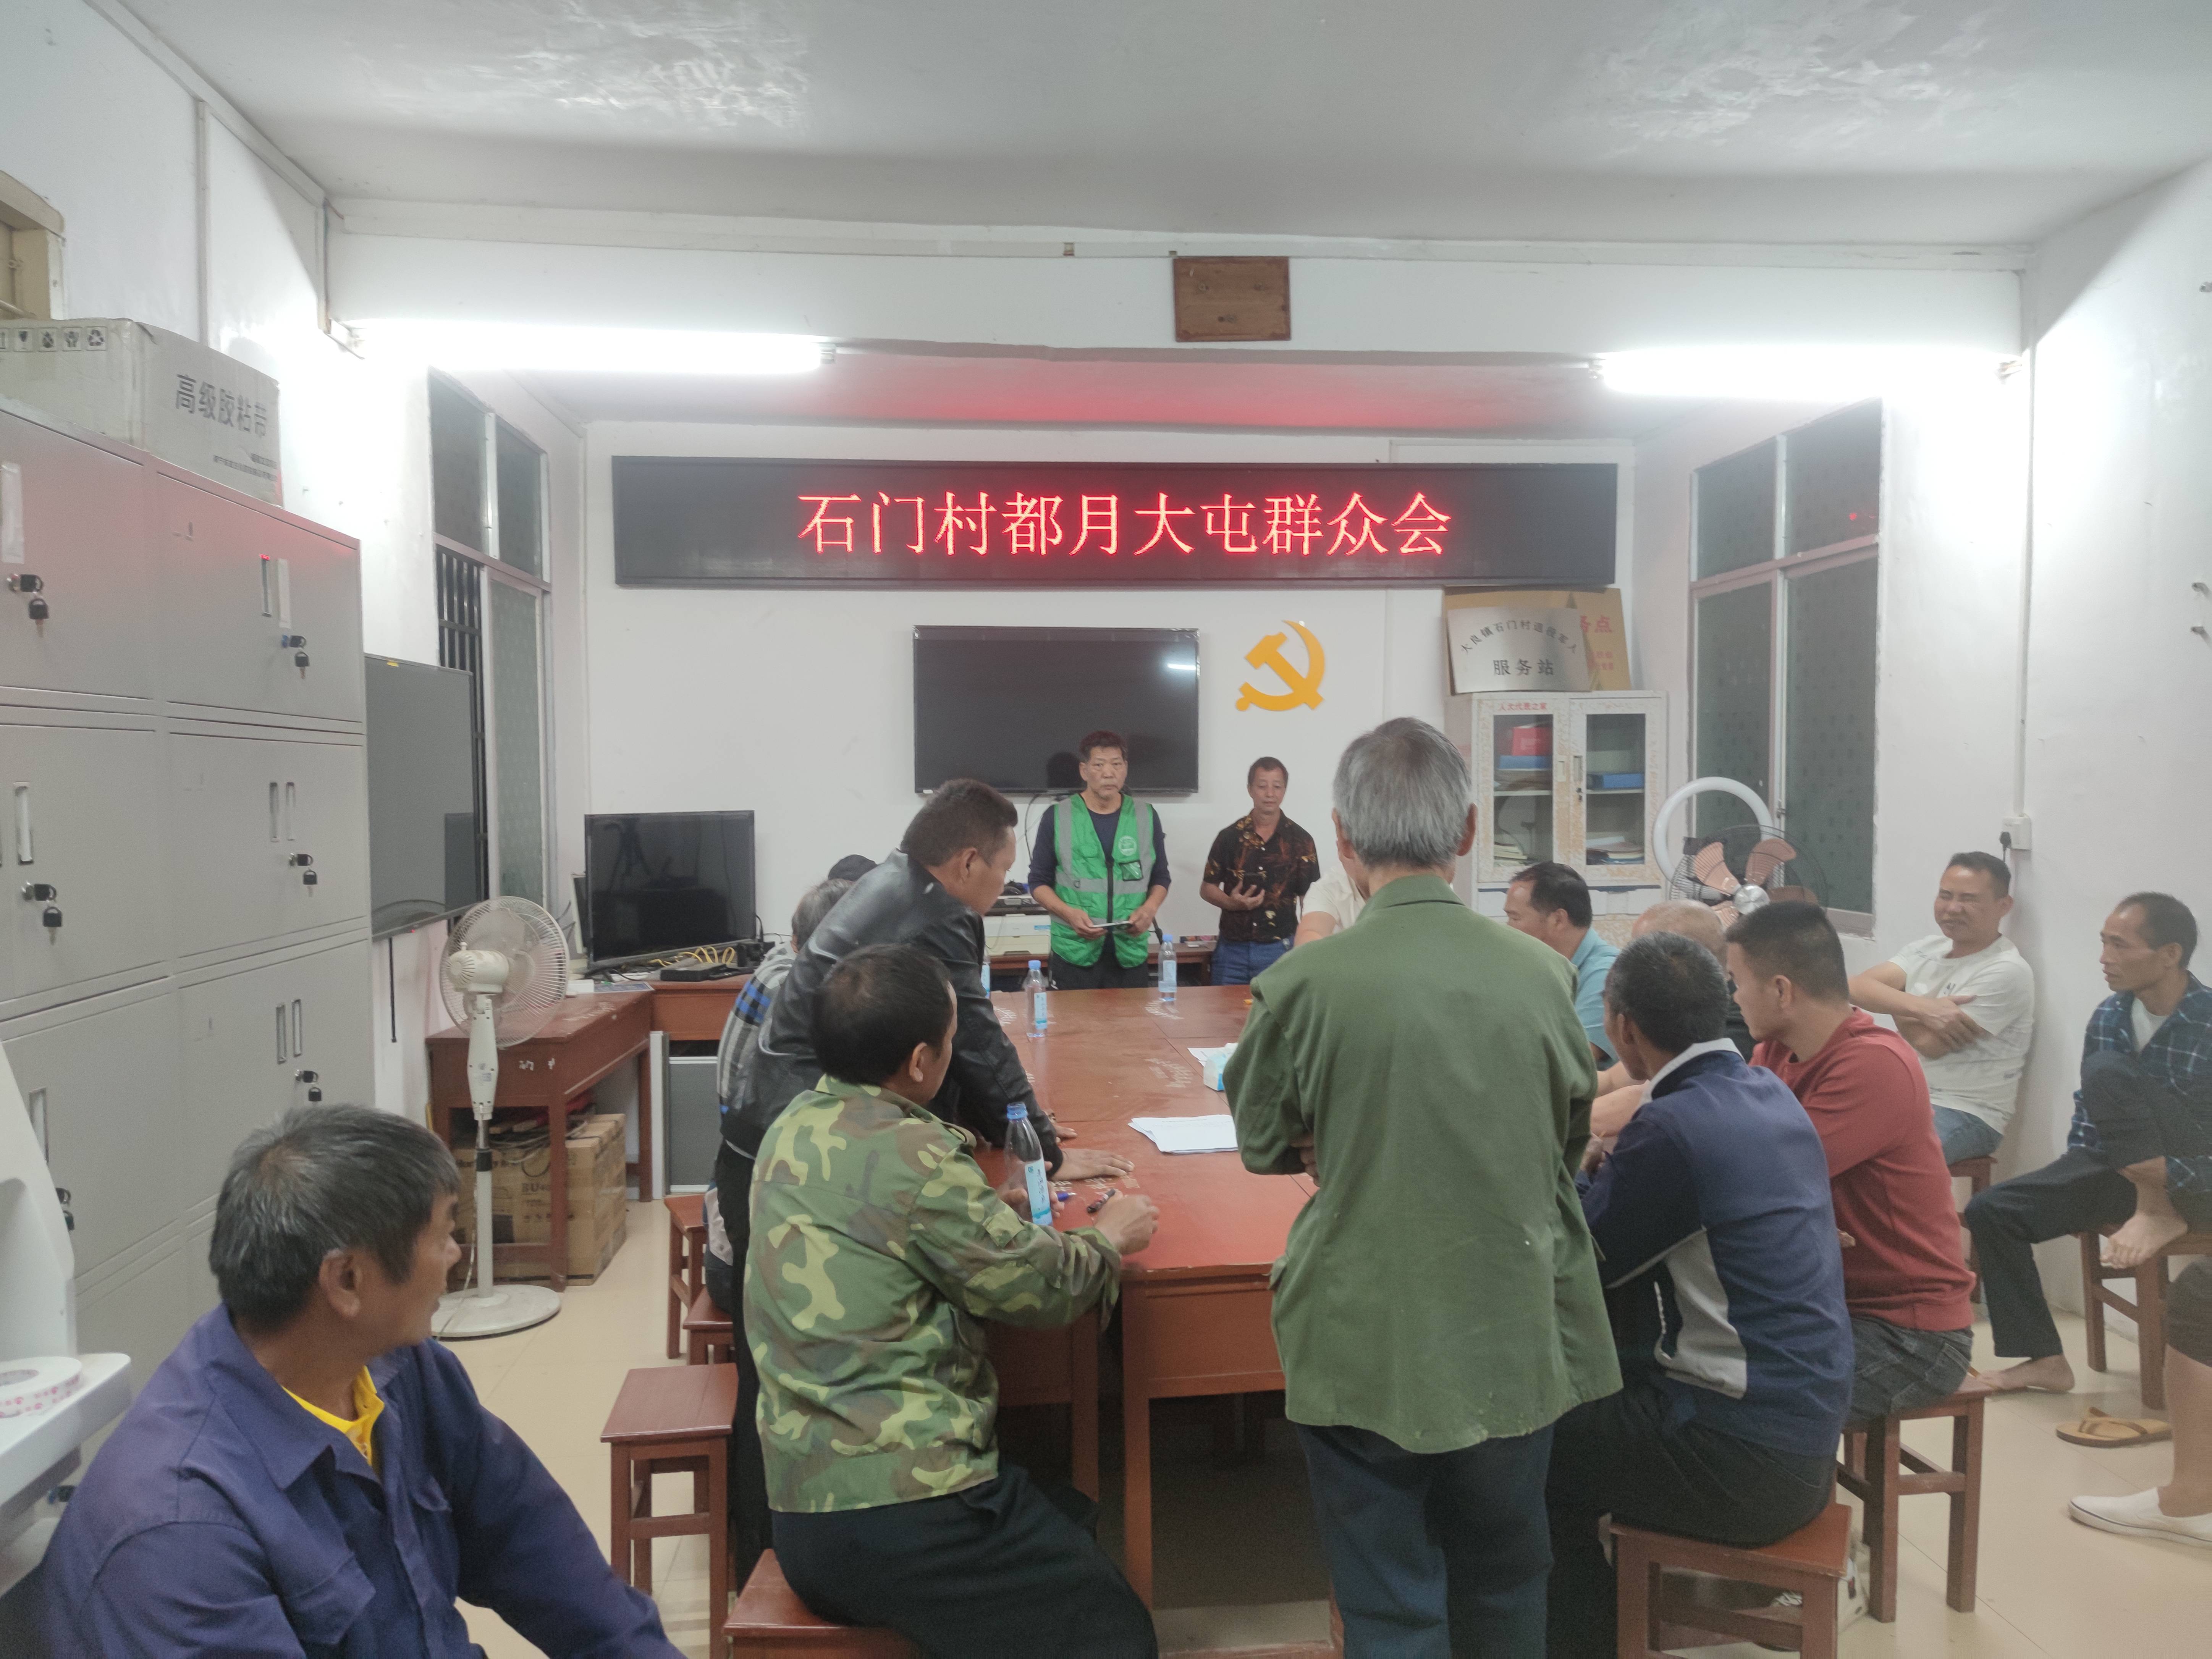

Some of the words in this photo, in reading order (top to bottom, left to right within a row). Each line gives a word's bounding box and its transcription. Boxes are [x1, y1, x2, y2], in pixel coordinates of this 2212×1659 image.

[176, 374, 267, 438] 高级胶粘带
[798, 491, 1451, 556] 石门村都月大屯群众会
[1493, 658, 1554, 675] 服务站
